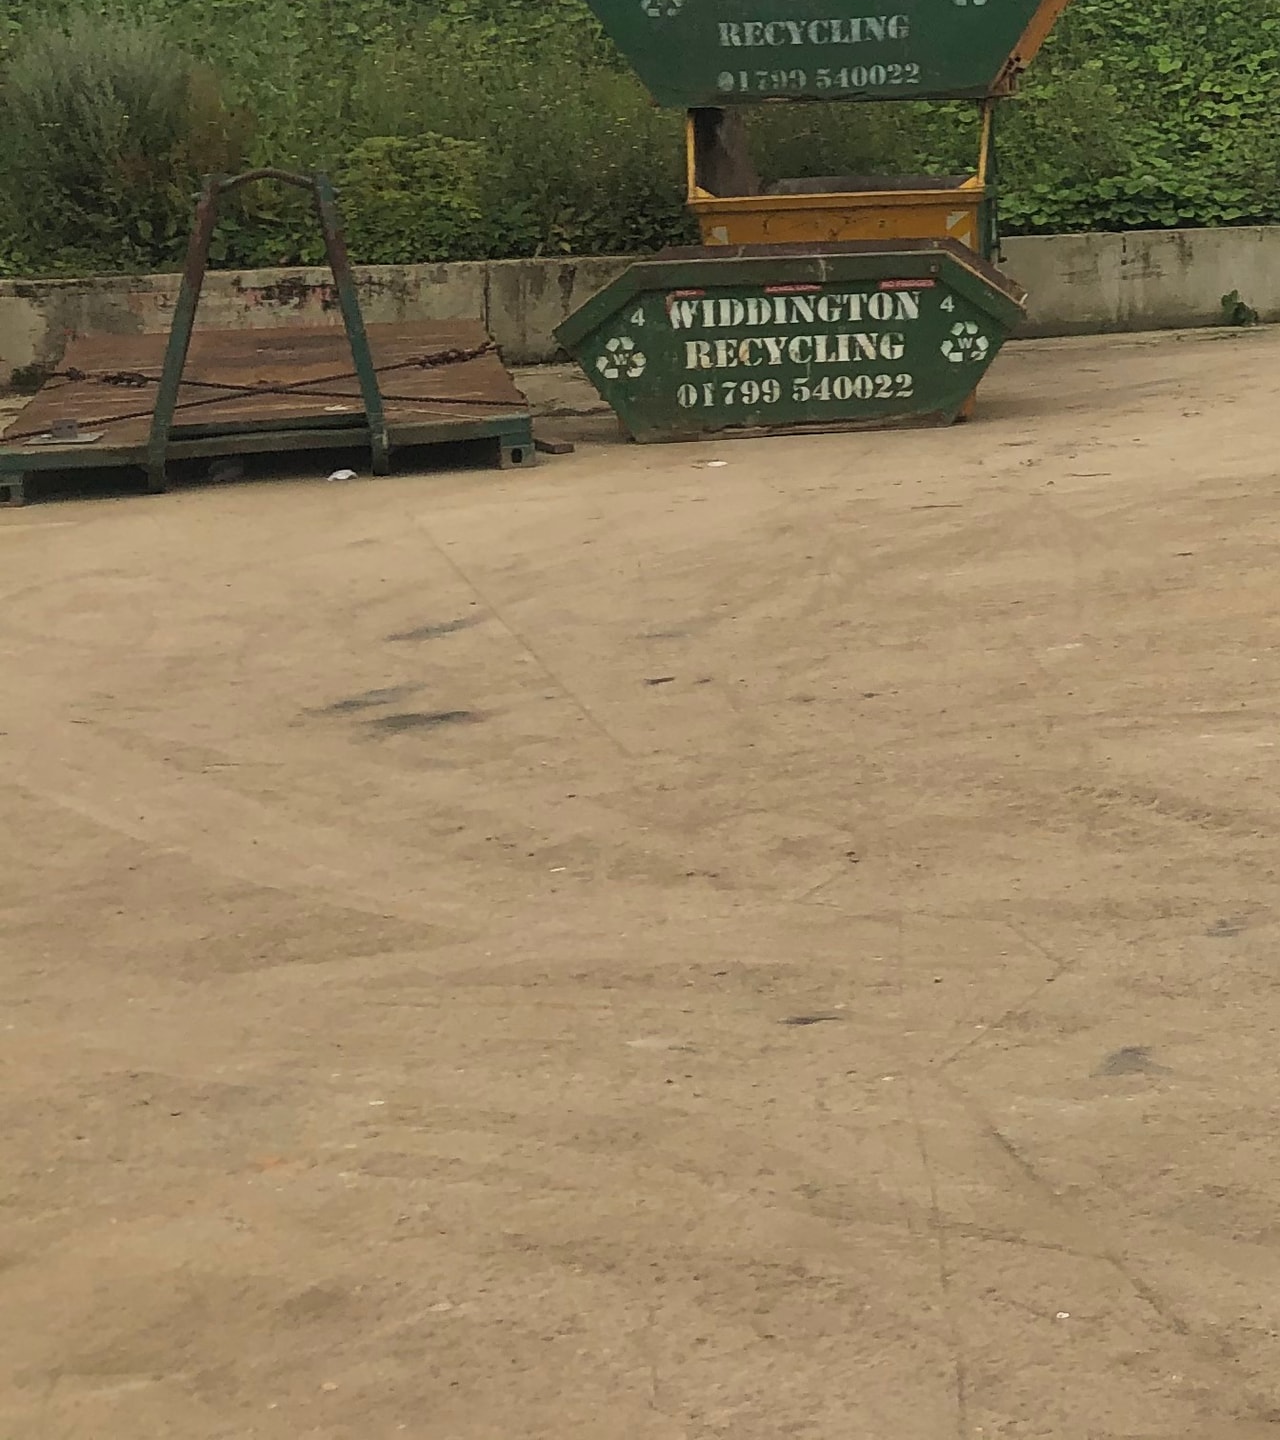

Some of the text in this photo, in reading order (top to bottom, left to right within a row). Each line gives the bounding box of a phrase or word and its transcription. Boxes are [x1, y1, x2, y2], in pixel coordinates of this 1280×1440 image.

[717, 14, 911, 48] RECYCLING
[815, 62, 921, 89] 540022
[630, 307, 646, 327] 4
[670, 291, 922, 330] WIDDINGTON
[939, 295, 956, 313] 4
[684, 331, 905, 370] RECYCLING
[956, 337, 973, 350] W
[676, 373, 915, 409] 01799 540022
